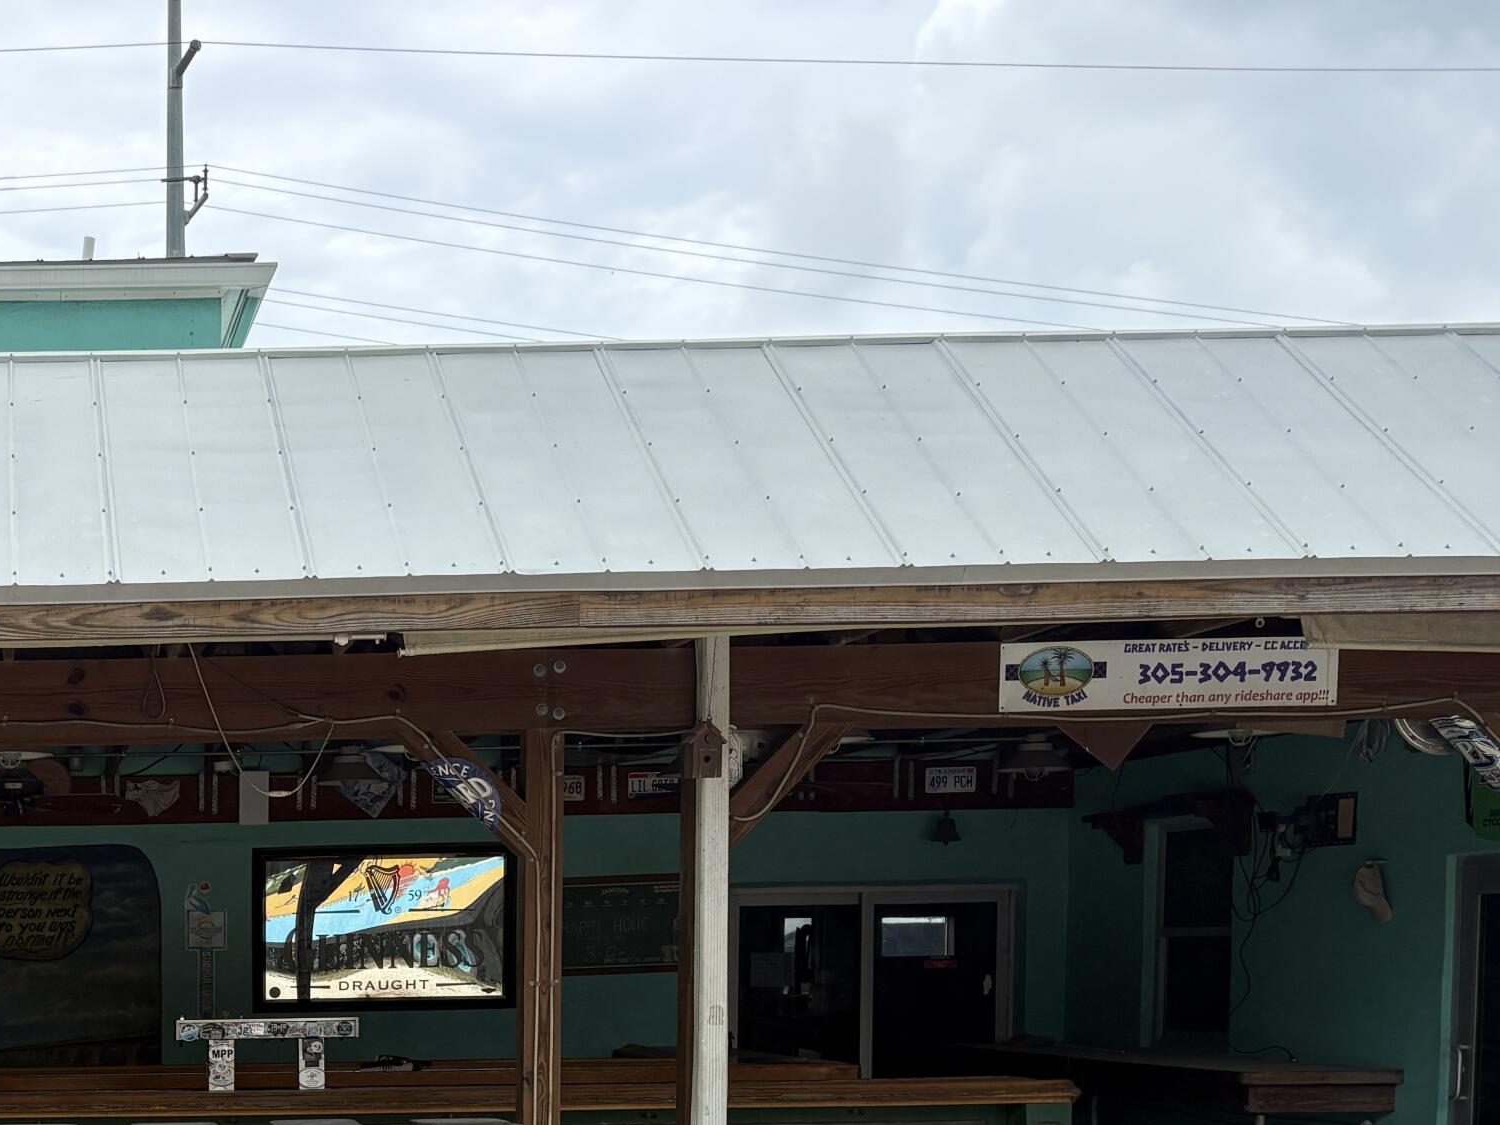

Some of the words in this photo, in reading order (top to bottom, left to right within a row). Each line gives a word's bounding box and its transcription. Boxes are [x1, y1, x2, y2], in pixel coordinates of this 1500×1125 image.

[1124, 642, 1156, 653] GREAT
[1159, 642, 1190, 653] RATES
[1201, 641, 1253, 652] DELIVERY
[1264, 640, 1277, 651] CC
[1138, 661, 1317, 685] 305-304-9932
[1023, 690, 1060, 708] NATIVE
[1063, 690, 1088, 705] TAXI
[1123, 692, 1173, 707] Cheaper
[1176, 691, 1206, 703] than
[1208, 692, 1231, 705] any
[1235, 690, 1293, 702] rideshare
[1296, 689, 1329, 704] app!!!
[930, 775, 947, 788] 499
[68, 872, 83, 885] be
[0, 889, 48, 906] strange
[408, 889, 422, 901] 59
[19, 922, 46, 934] you
[49, 920, 77, 934] was
[338, 980, 429, 991] DRAUGHT
[211, 1049, 234, 1059] MPP
